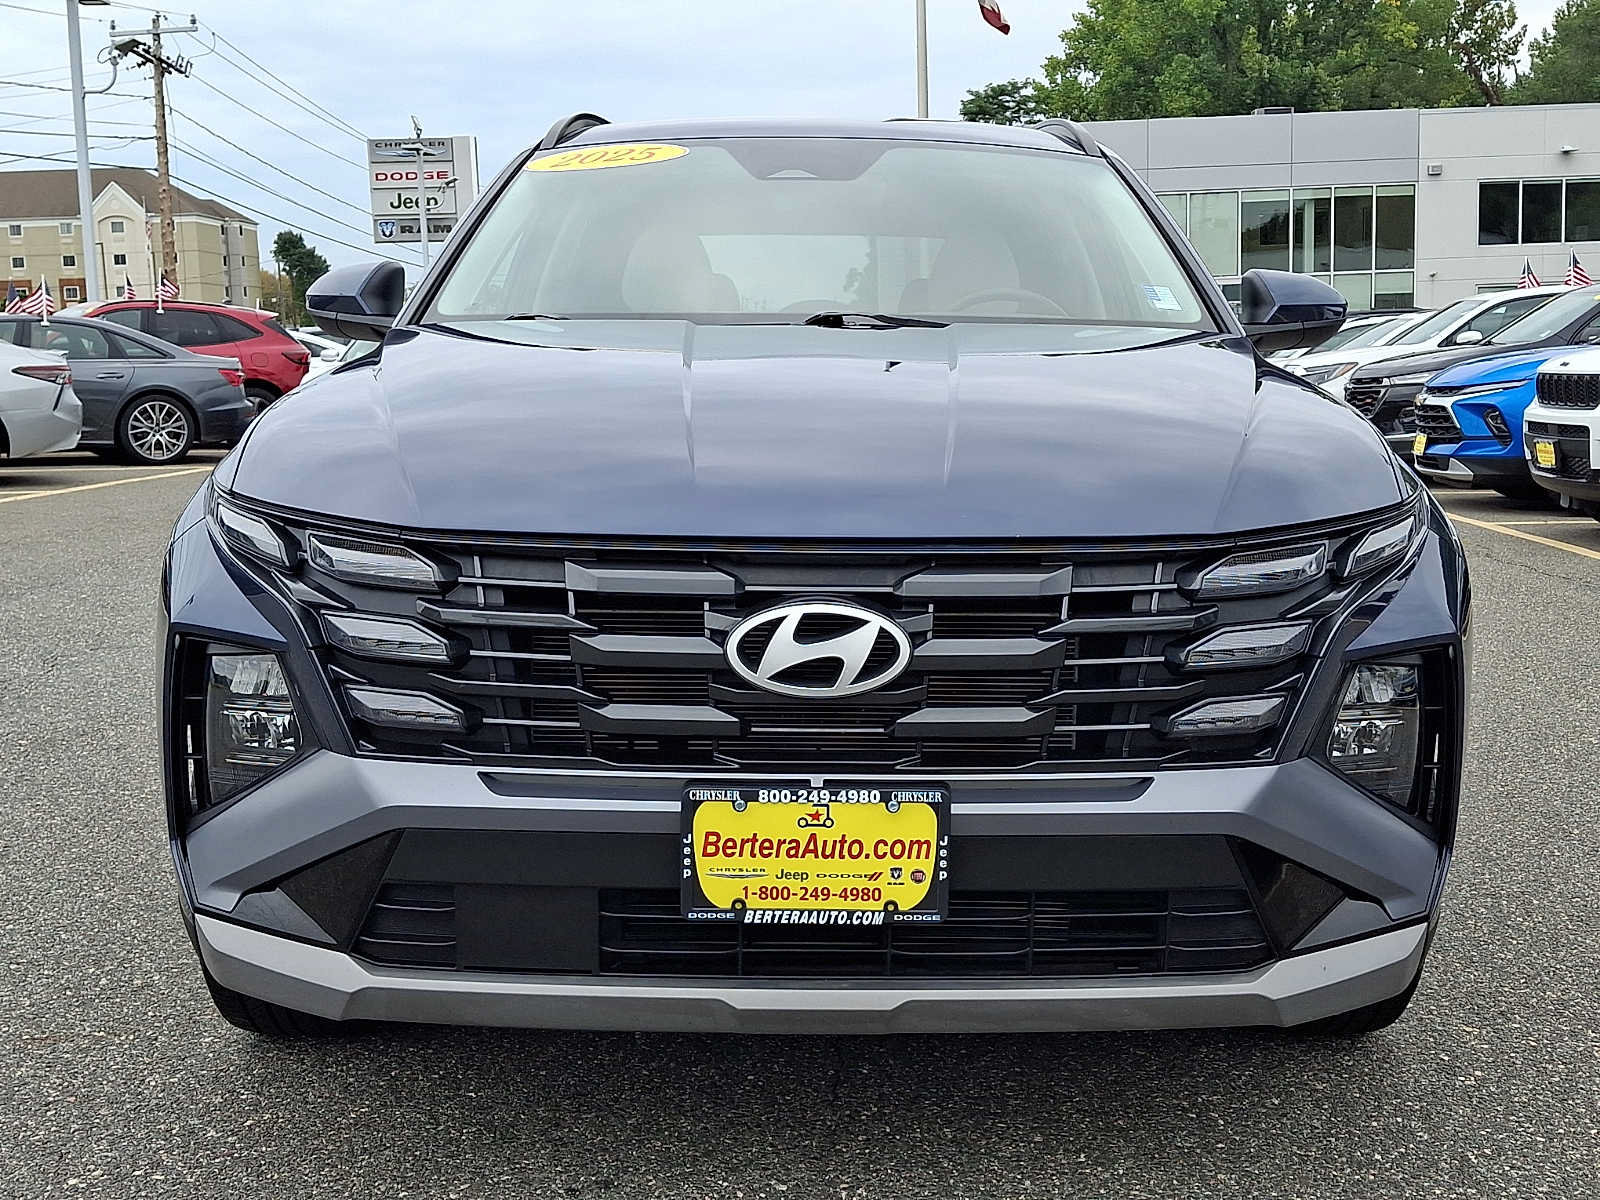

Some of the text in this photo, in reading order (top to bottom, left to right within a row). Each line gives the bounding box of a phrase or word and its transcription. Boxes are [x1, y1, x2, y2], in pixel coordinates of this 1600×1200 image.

[550, 147, 662, 168] 2025
[375, 170, 449, 181] DODGE
[689, 789, 741, 801] CHRYSLER
[758, 789, 881, 804] 800-249-4980
[891, 790, 942, 802] CHRYSLER
[701, 831, 931, 860] BerteraAuto.com
[682, 833, 692, 879] Jeep
[938, 835, 948, 881] Jeep
[775, 868, 809, 882] Jeep
[742, 885, 882, 902] 1-800-249-4980
[743, 909, 885, 926] BERTERAAUTO.COM
